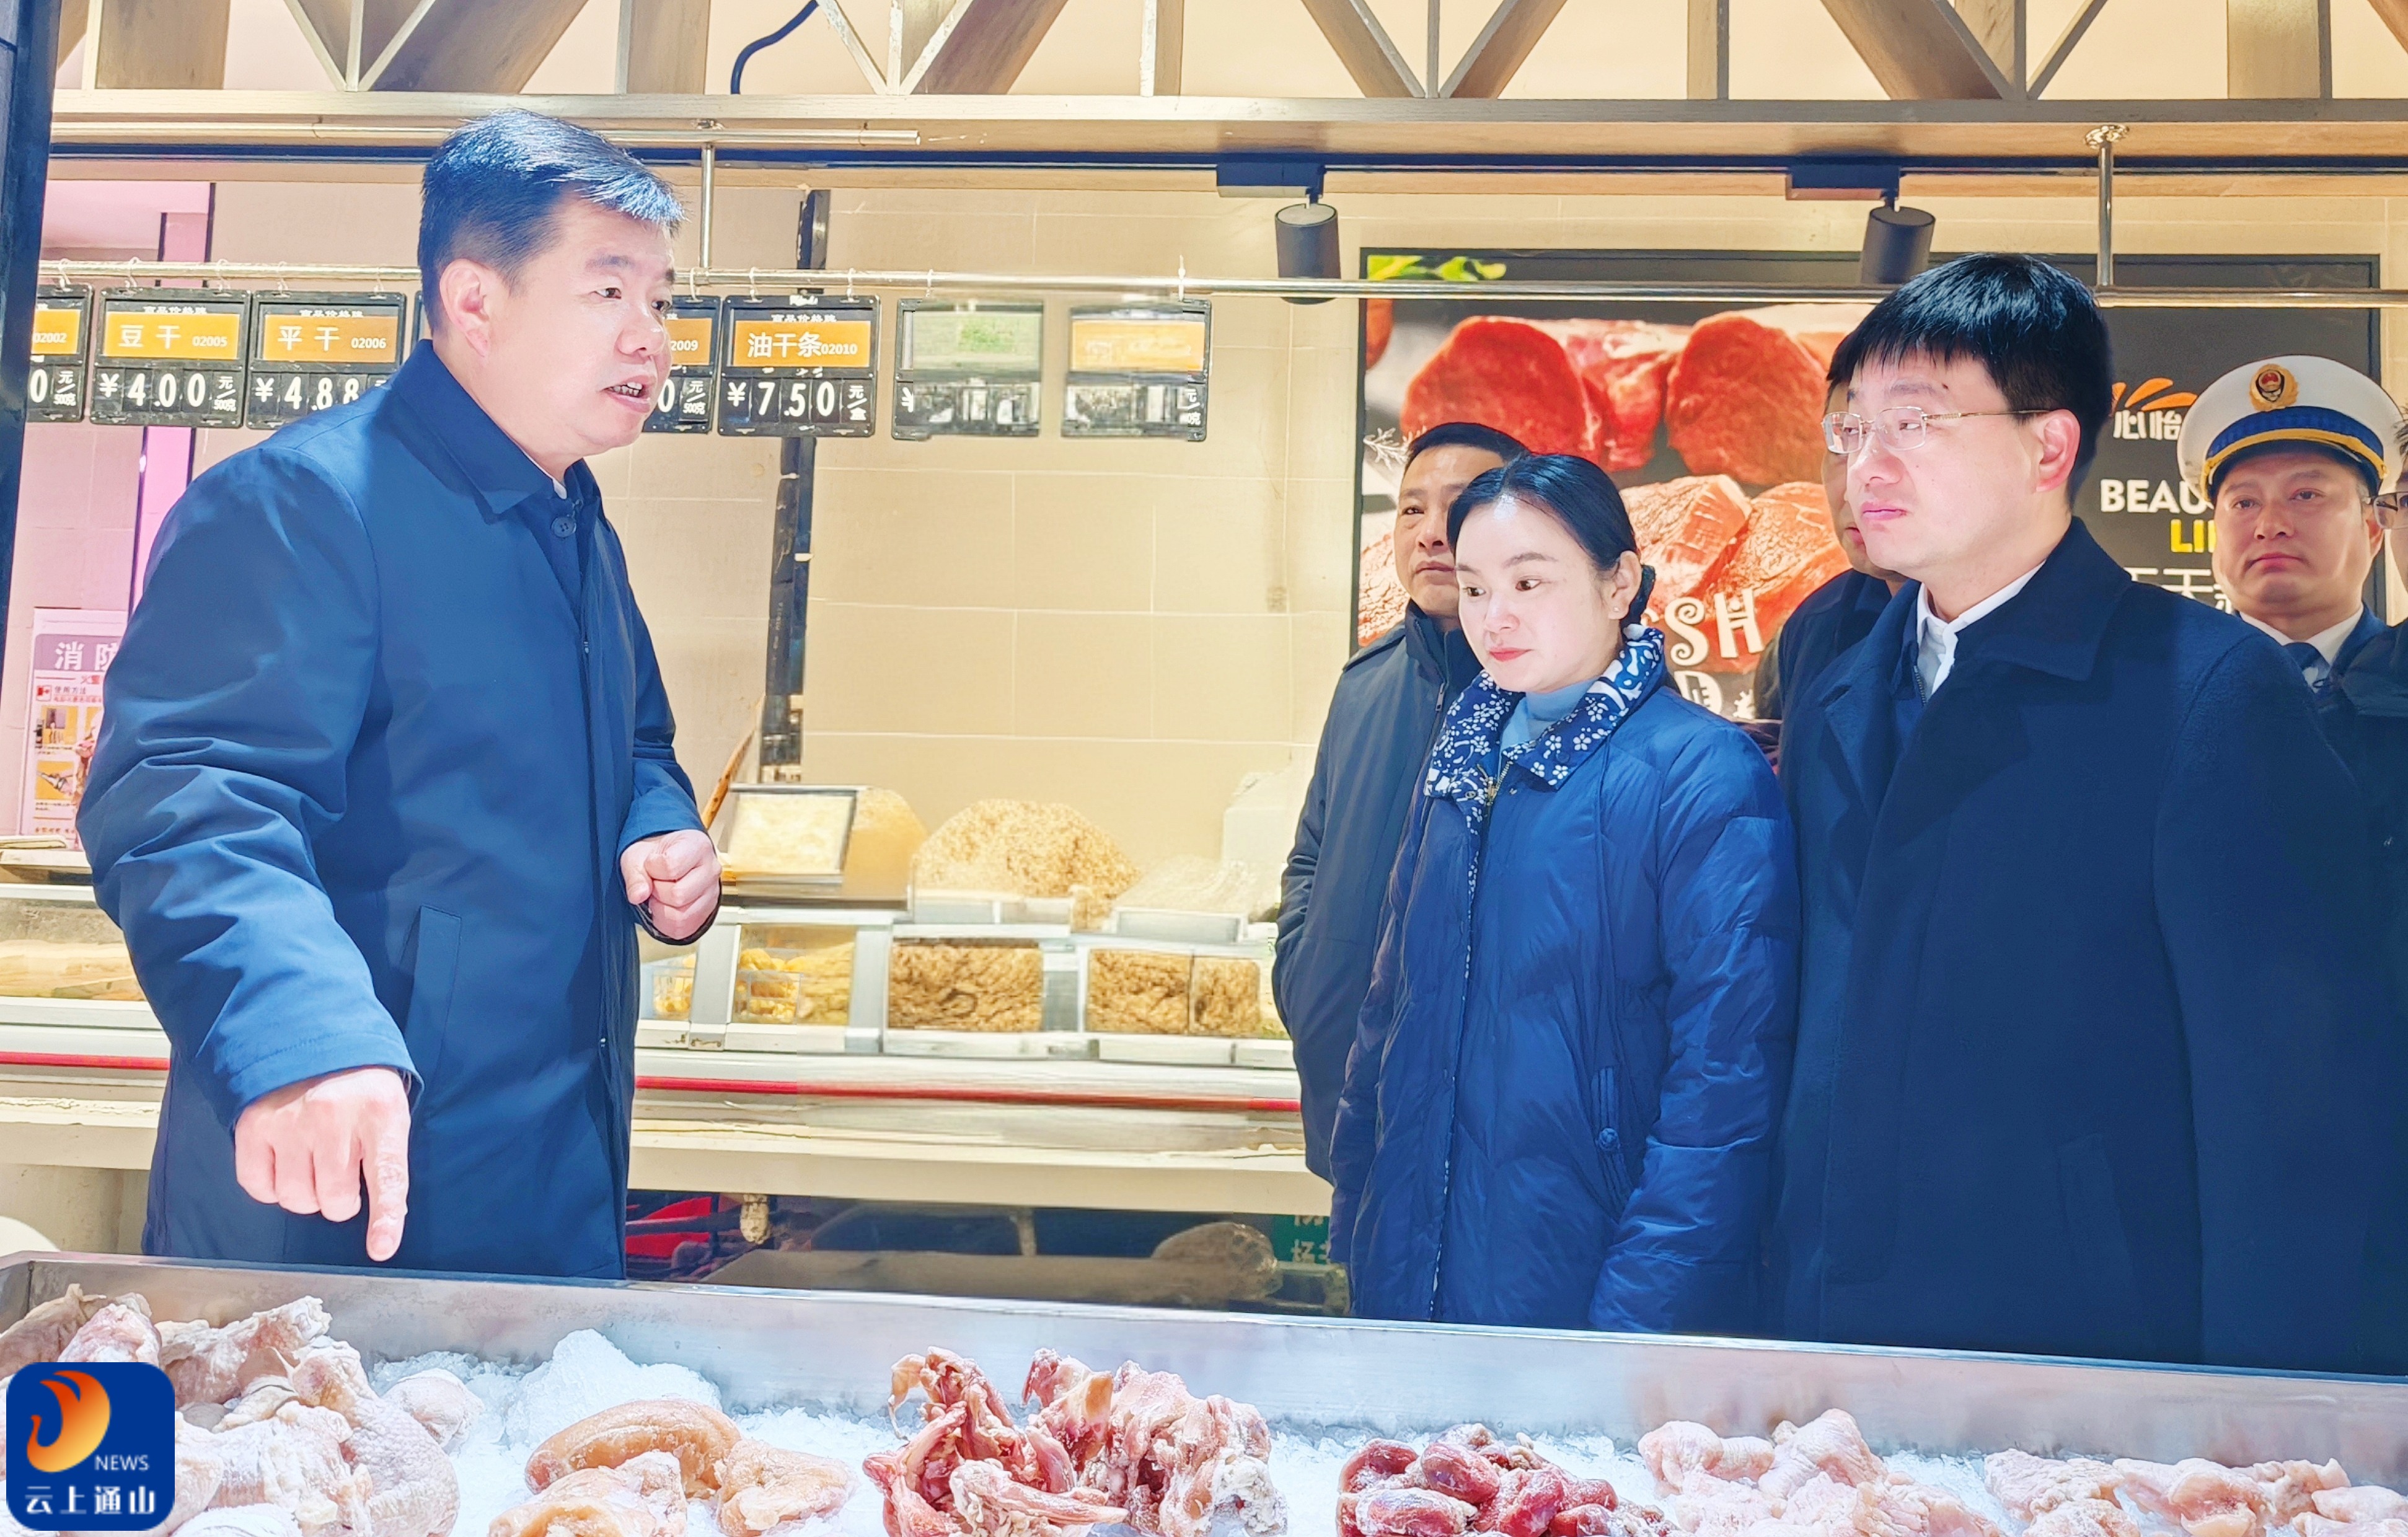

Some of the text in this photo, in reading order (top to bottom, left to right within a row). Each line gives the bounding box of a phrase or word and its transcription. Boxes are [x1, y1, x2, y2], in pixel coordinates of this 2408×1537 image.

[118, 325, 228, 349] 豆干 02005
[278, 325, 387, 351] 平干 02006
[671, 340, 699, 351] 2009
[748, 332, 858, 358] 油干条 02010
[2101, 478, 2208, 514] BEAU
[1640, 589, 1765, 666] SH
